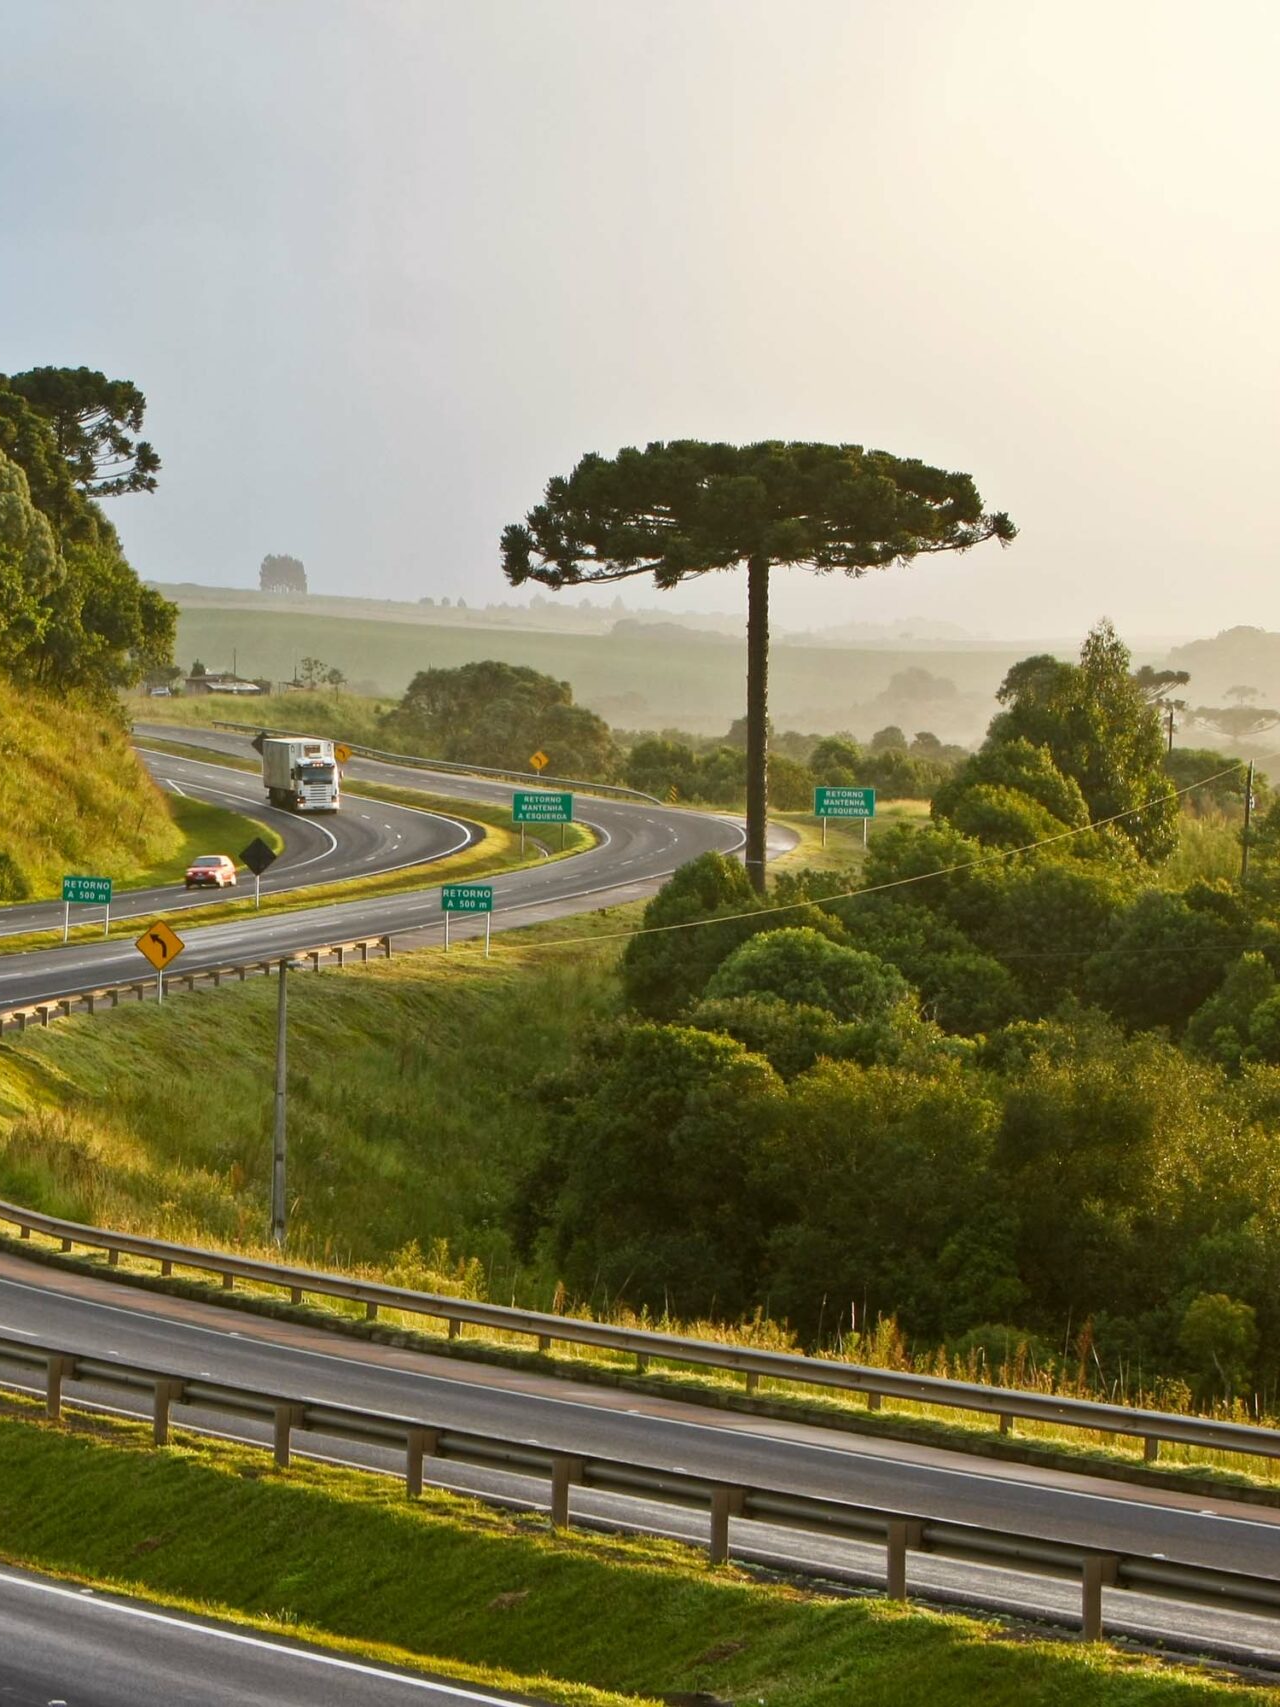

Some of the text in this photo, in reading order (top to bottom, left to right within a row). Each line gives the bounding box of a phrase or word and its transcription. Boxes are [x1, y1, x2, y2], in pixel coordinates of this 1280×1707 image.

[823, 799, 866, 807] MANTENHA
[525, 812, 568, 820] ESQUERDA
[64, 879, 110, 890] RETORNO
[67, 890, 75, 898] A
[79, 891, 95, 900] 500
[442, 889, 491, 898] RETORNO
[447, 900, 454, 908] A
[459, 900, 476, 908] 500
